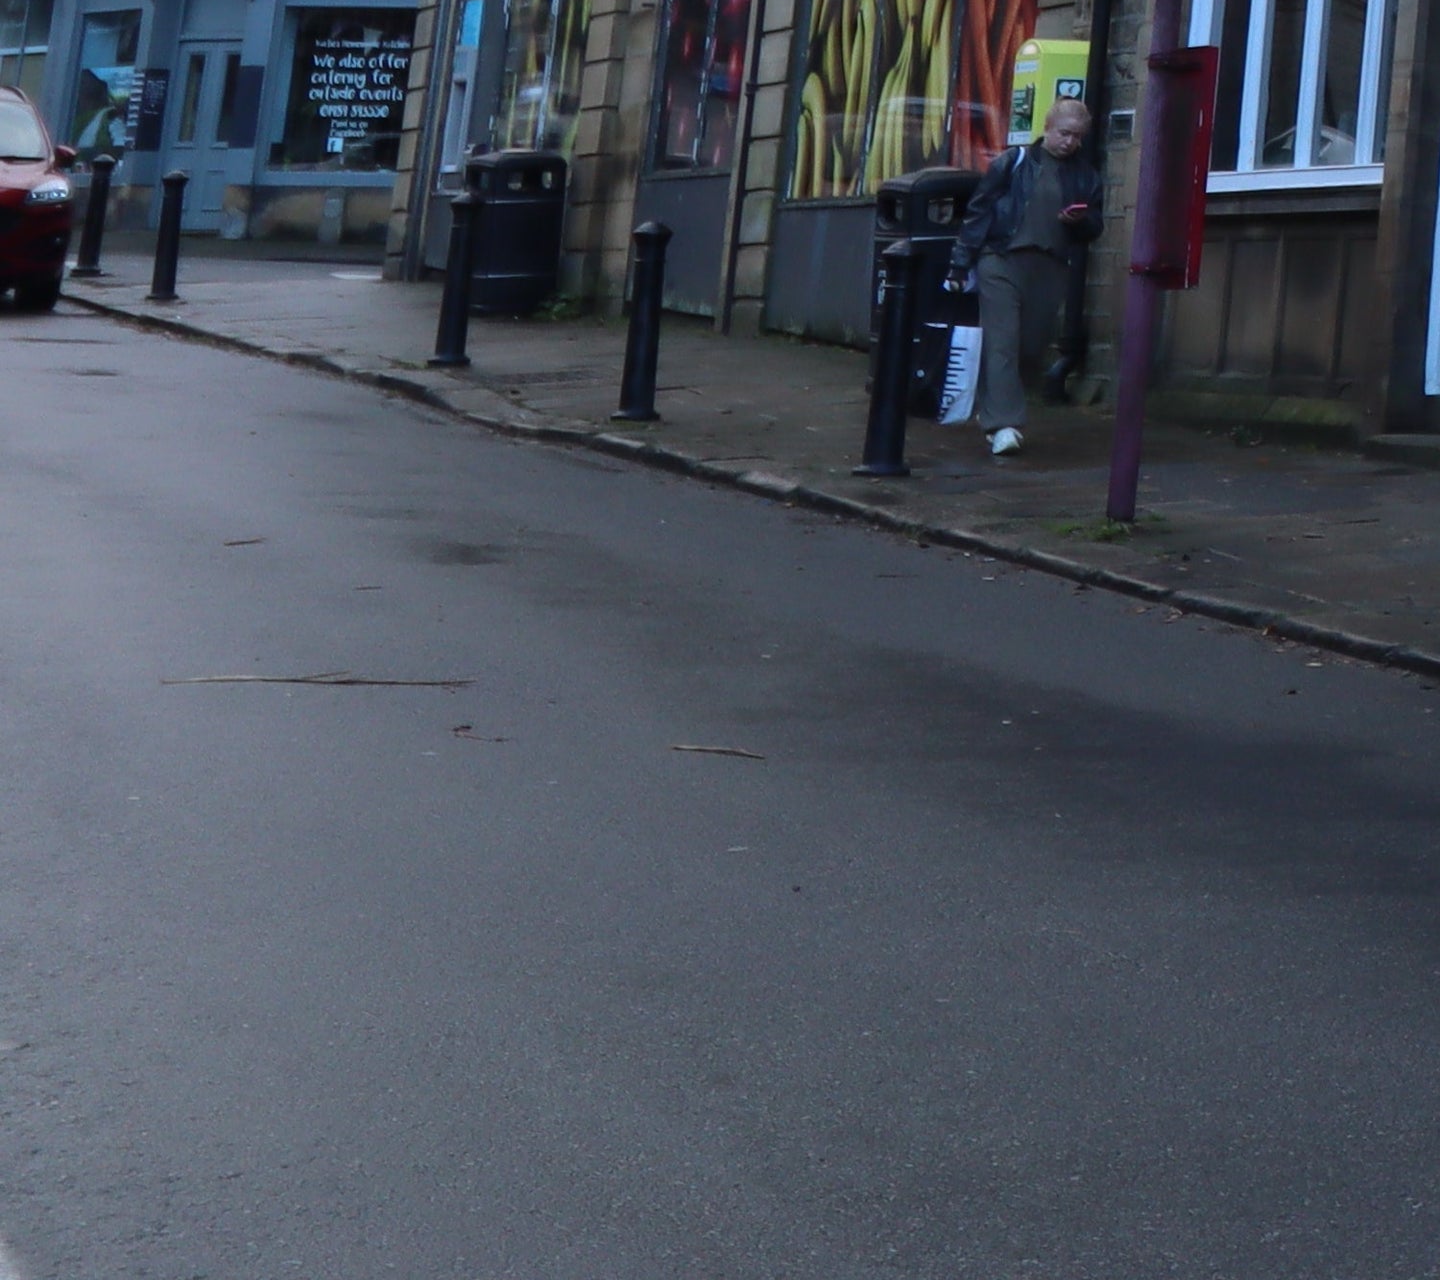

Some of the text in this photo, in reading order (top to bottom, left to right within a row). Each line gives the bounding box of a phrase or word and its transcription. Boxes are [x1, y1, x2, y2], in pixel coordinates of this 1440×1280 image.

[339, 53, 366, 68] also
[368, 53, 408, 69] offer
[311, 69, 394, 89] catering for
[309, 85, 403, 101] outside events
